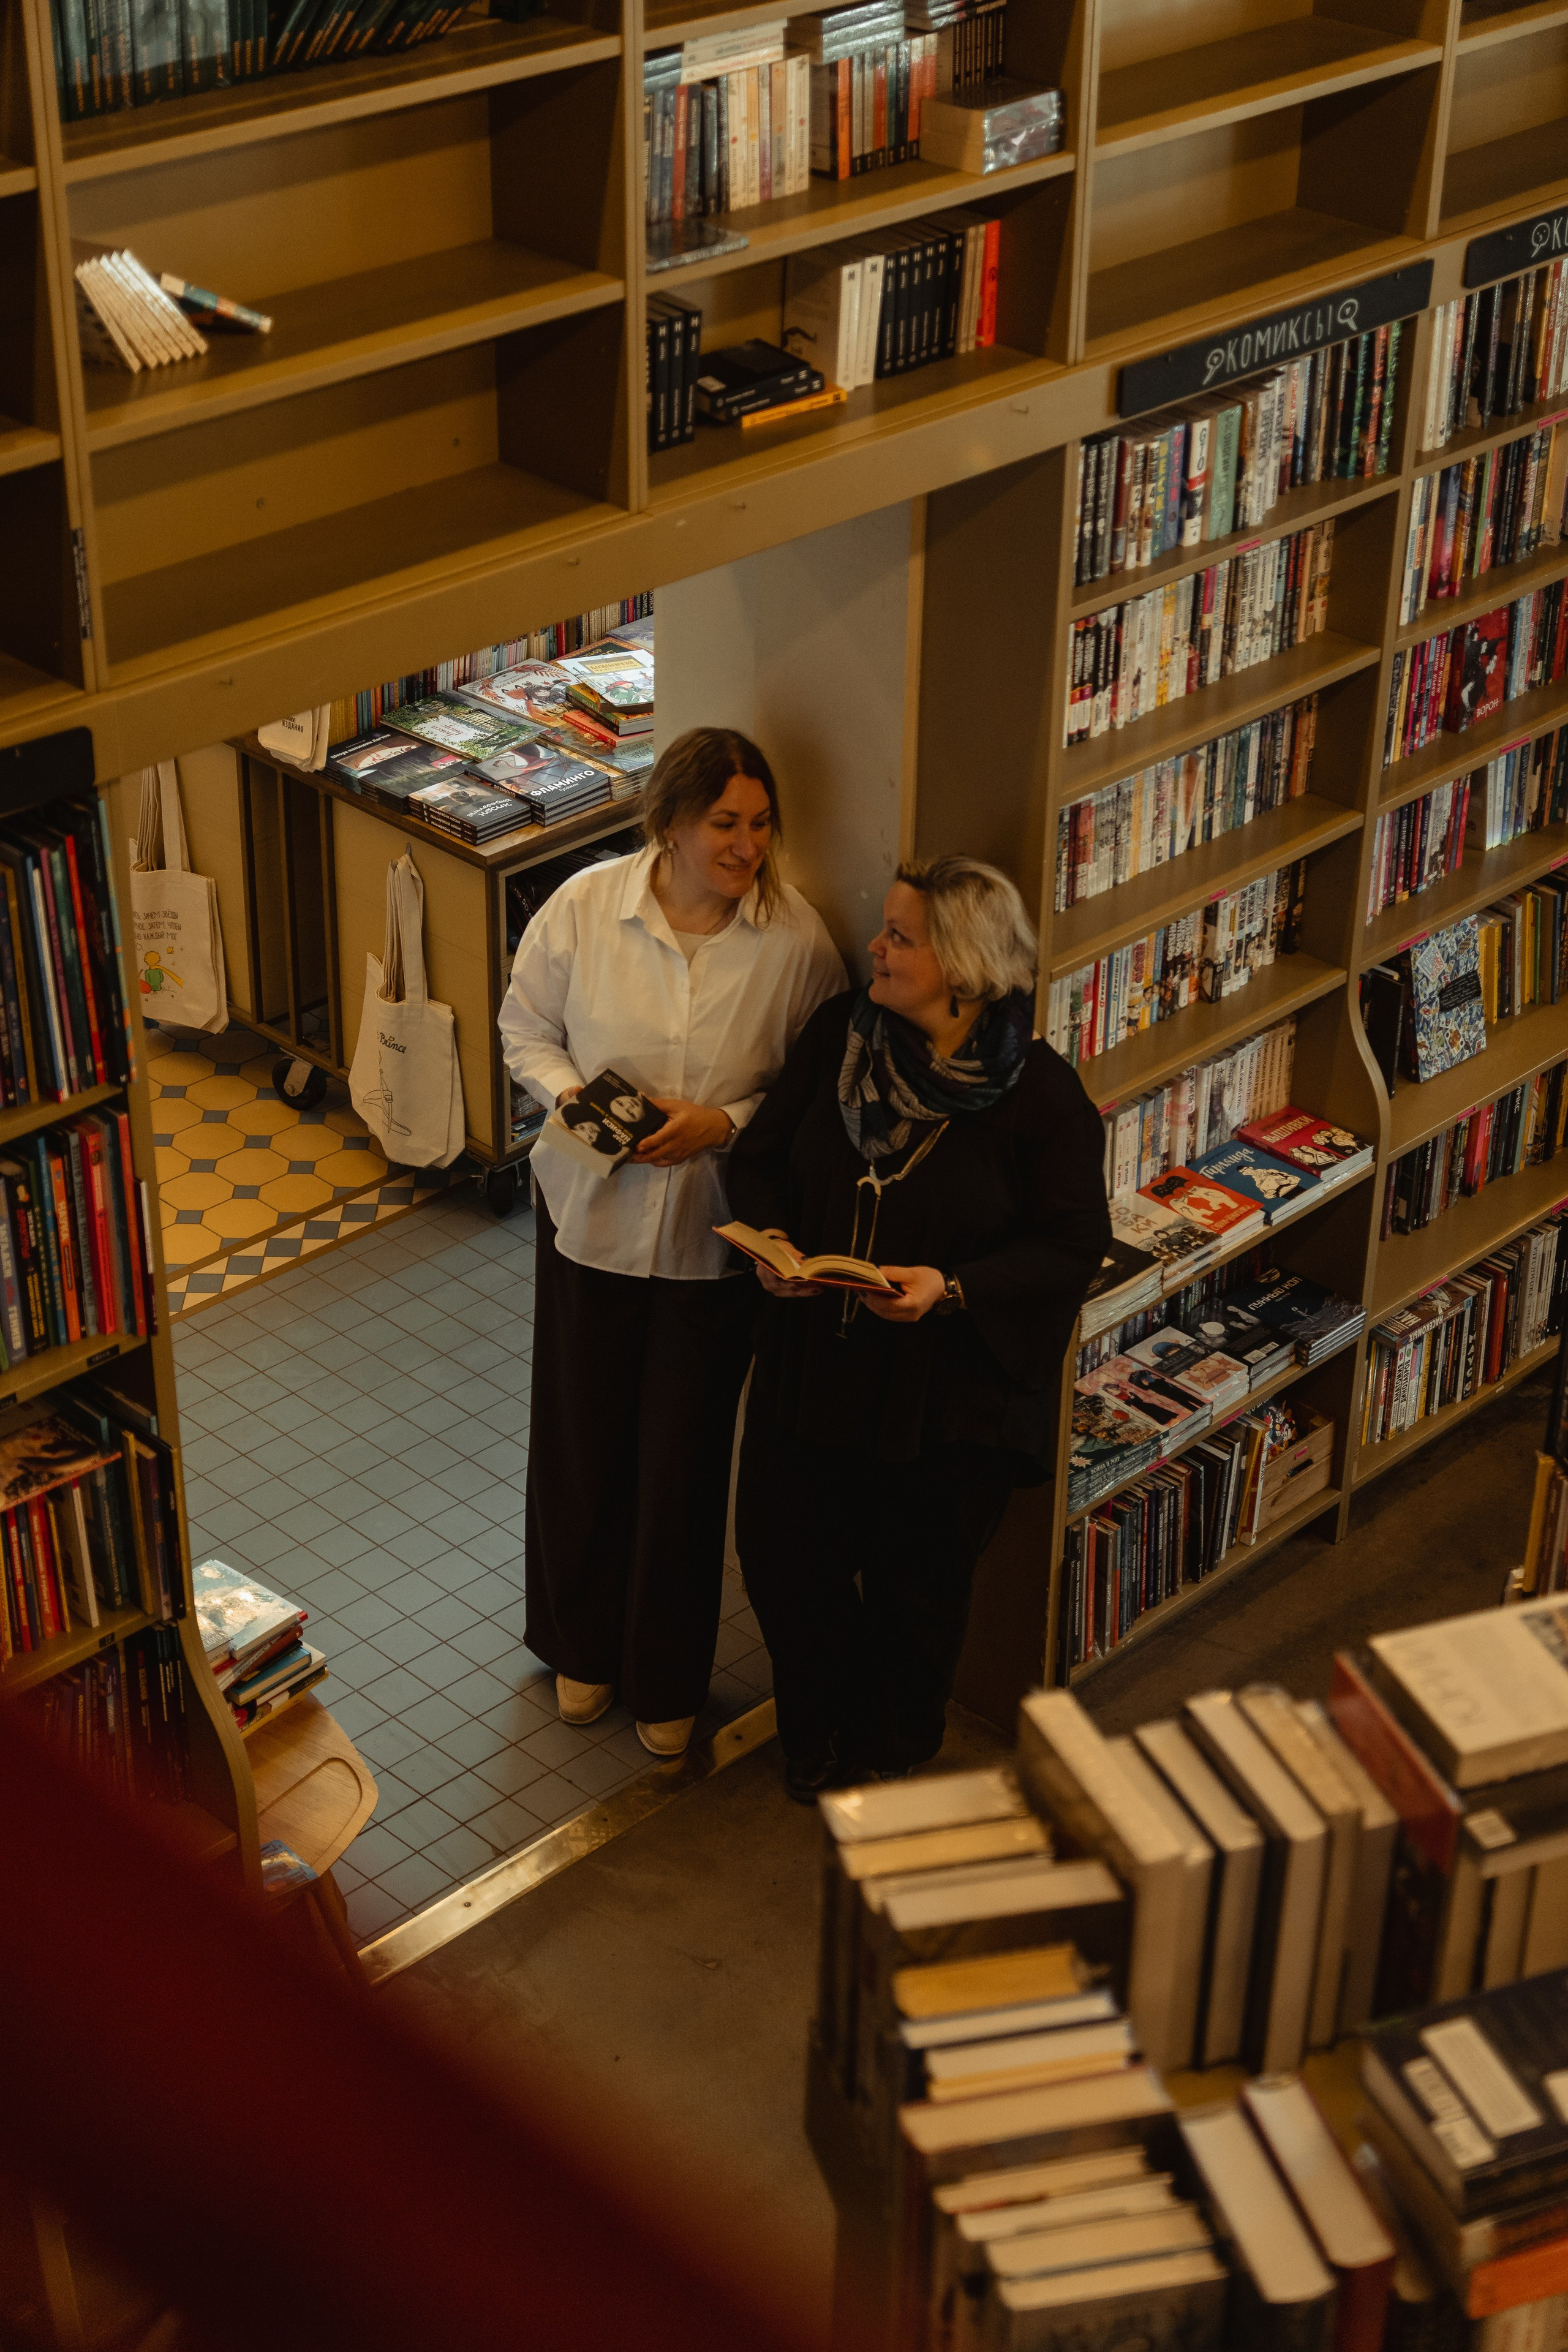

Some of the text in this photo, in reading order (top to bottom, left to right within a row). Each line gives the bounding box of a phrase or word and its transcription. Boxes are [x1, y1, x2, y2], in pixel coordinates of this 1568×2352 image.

[1226, 304, 1333, 374] КОМИКСЫ
[1476, 697, 1499, 718] ВОРОН
[282, 718, 304, 733] ИЗДАНИЯ
[530, 769, 595, 797] ФЛАМИНГО
[143, 911, 160, 920] ЗАЧЕМ
[143, 931, 165, 940] КАЖДЫЙ
[166, 932, 178, 940] МОГ
[380, 1032, 407, 1054] Prince
[601, 1118, 631, 1142] НАФИСИ
[612, 1133, 628, 1145] АЗАР
[1262, 1115, 1315, 1144] ВЫШИВКИ
[1199, 1147, 1256, 1180] Гирлянда
[1528, 1246, 1538, 1298] PATCHWORK
[1408, 1316, 1444, 1343] НАСЕКОМЫХ
[1394, 1363, 1404, 1403] АНАТОМИЯ
[1400, 1359, 1411, 1403] ДИНОЗАВРОВ
